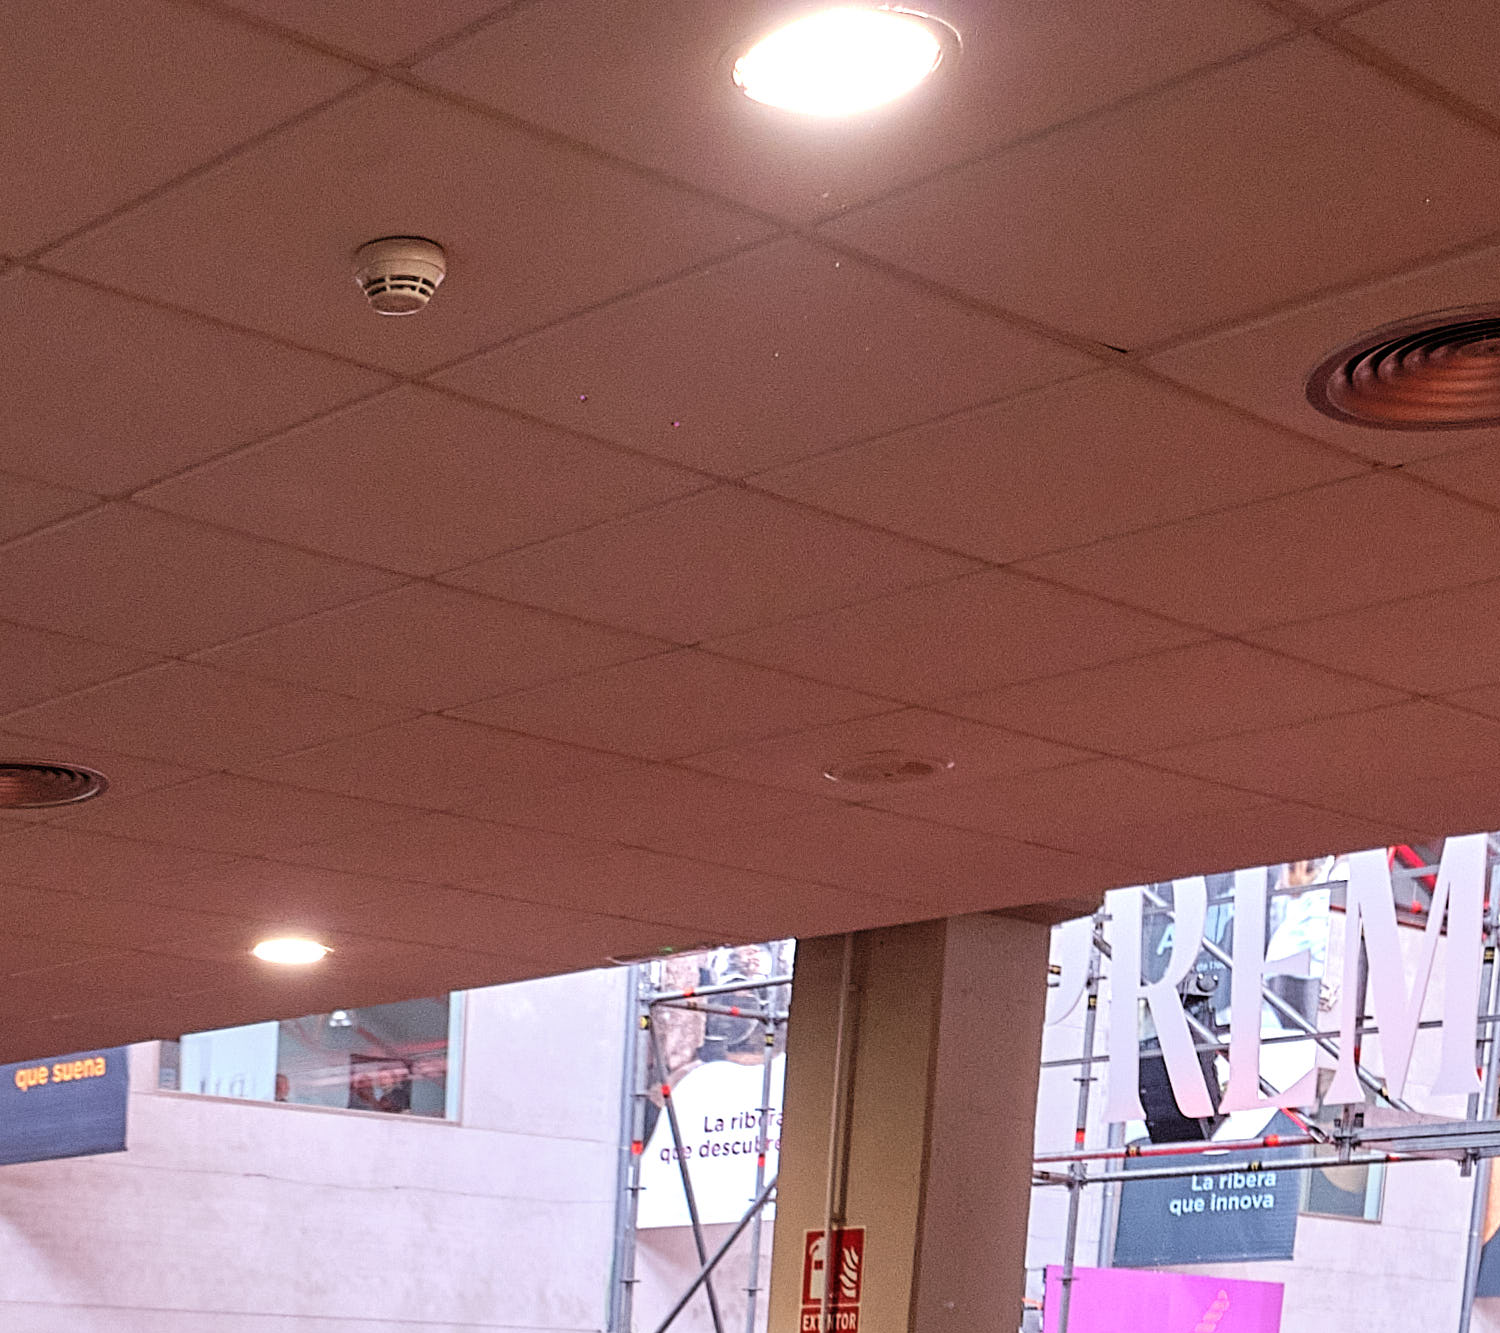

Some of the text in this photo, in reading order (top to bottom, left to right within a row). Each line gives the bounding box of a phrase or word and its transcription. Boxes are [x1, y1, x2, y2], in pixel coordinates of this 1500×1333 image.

[14, 1057, 106, 1092] que suena
[704, 1116, 725, 1133] La
[1192, 1172, 1277, 1192] La ribera
[1169, 1193, 1275, 1216] que innova
